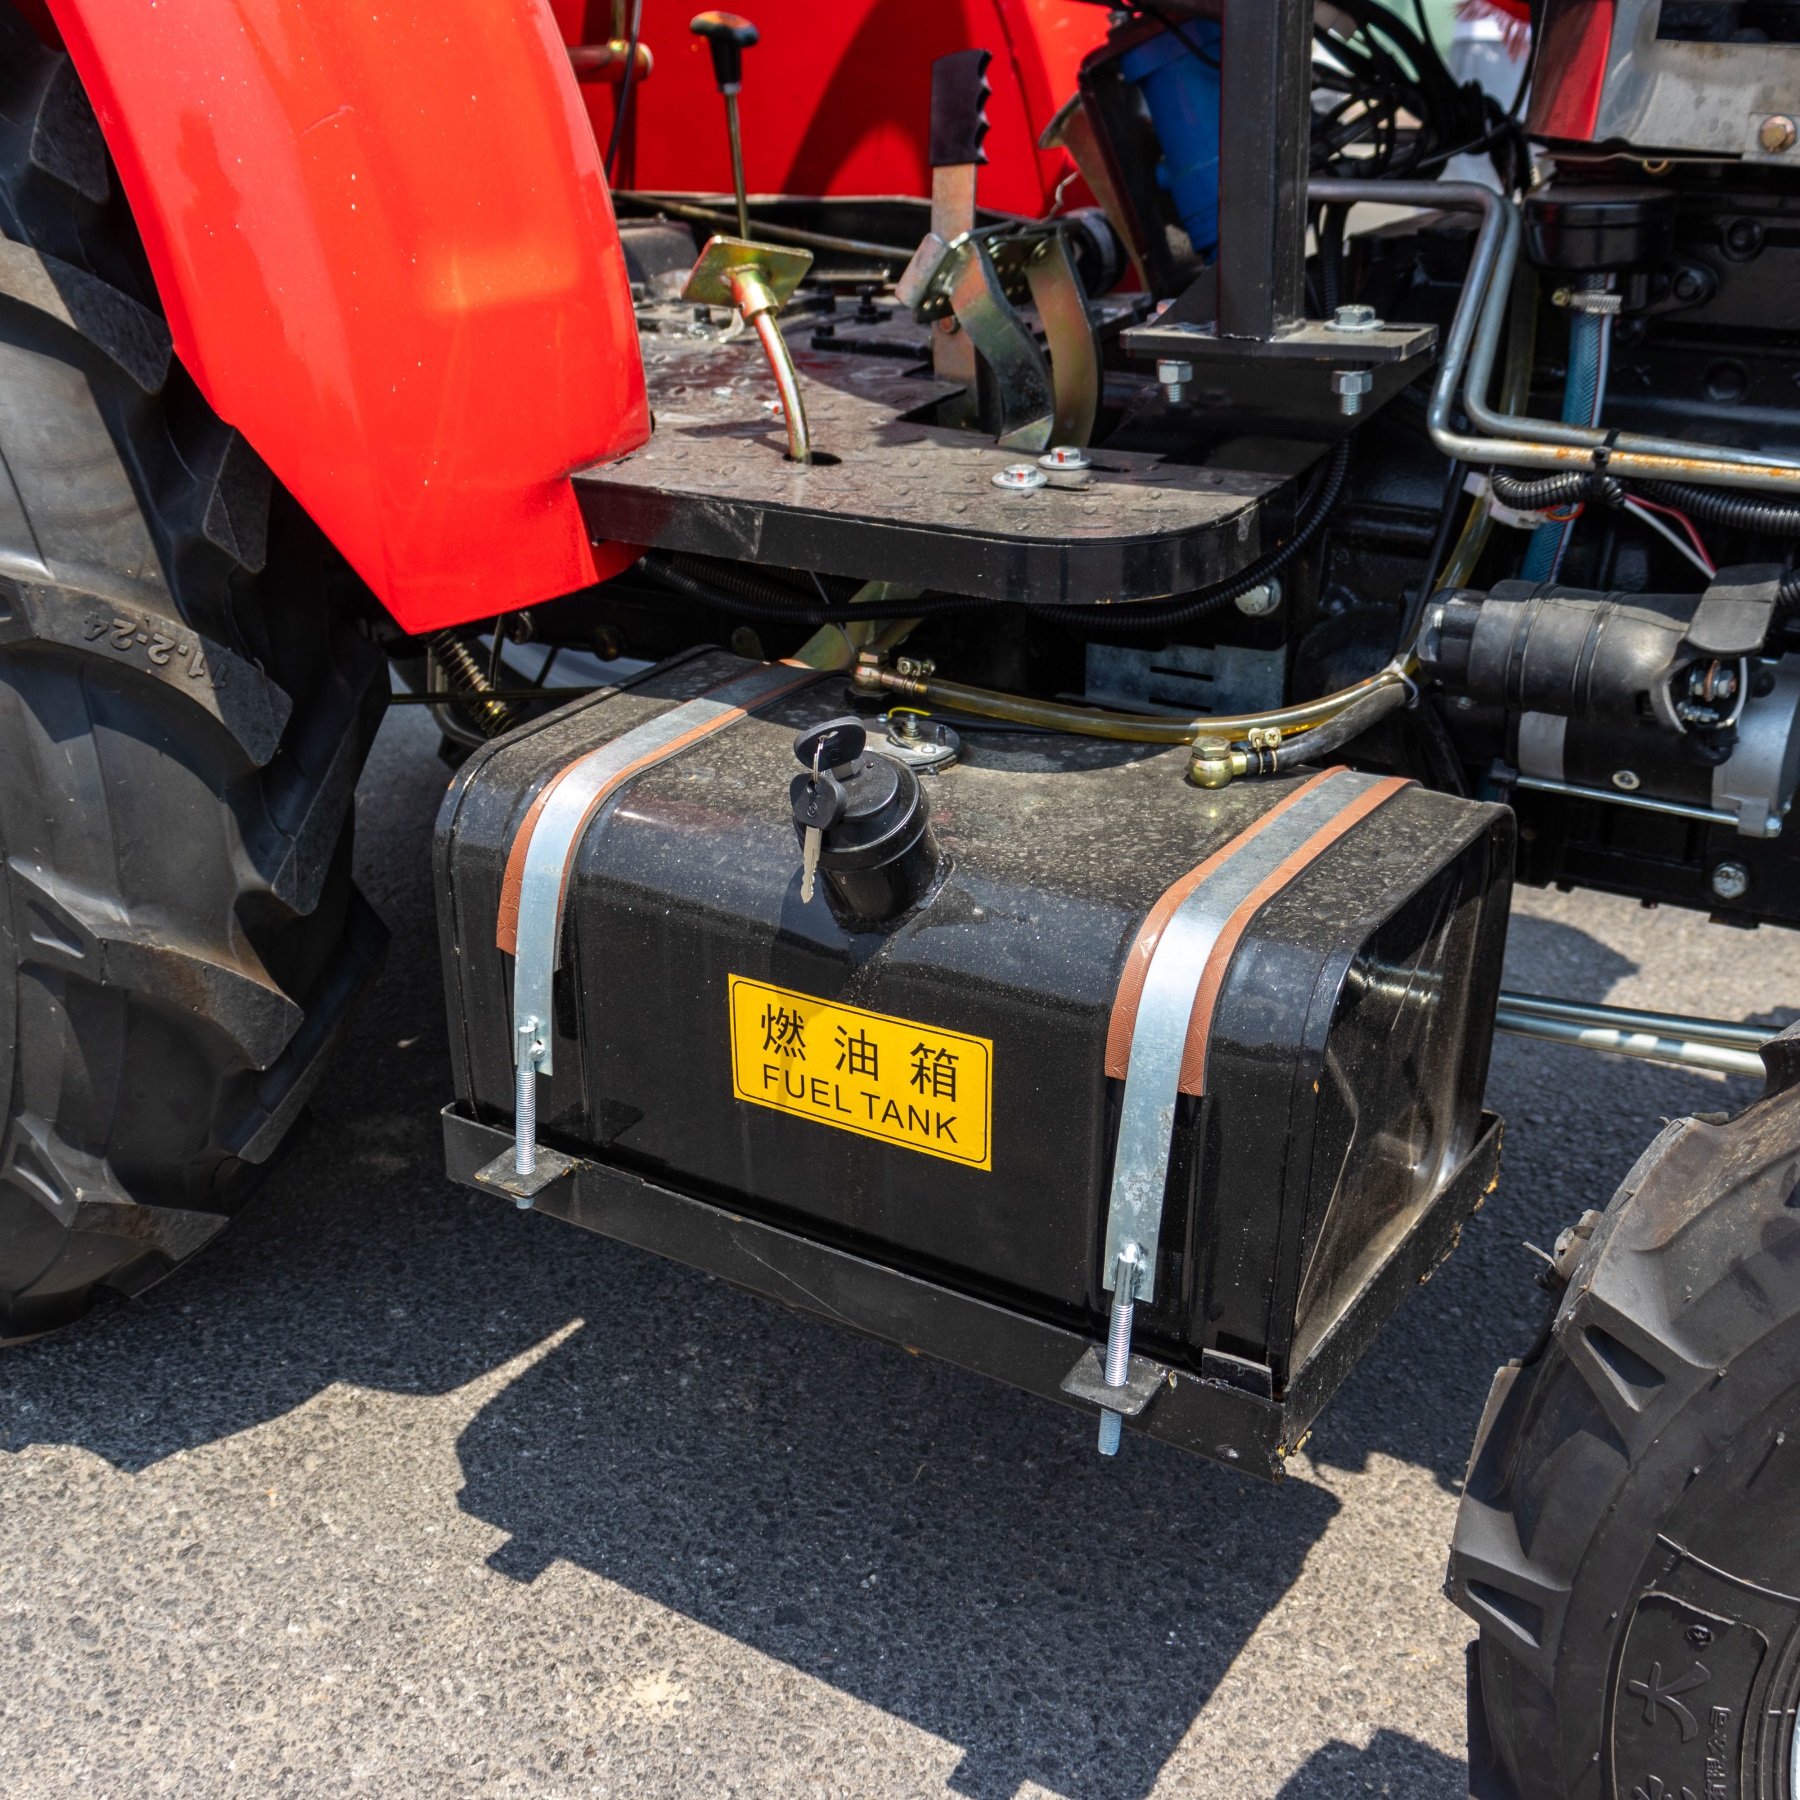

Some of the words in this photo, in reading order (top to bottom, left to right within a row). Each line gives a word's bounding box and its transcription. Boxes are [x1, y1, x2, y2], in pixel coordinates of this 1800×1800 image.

[83, 611, 227, 689] 11.2-24
[761, 1003, 959, 1102] 燃油箱
